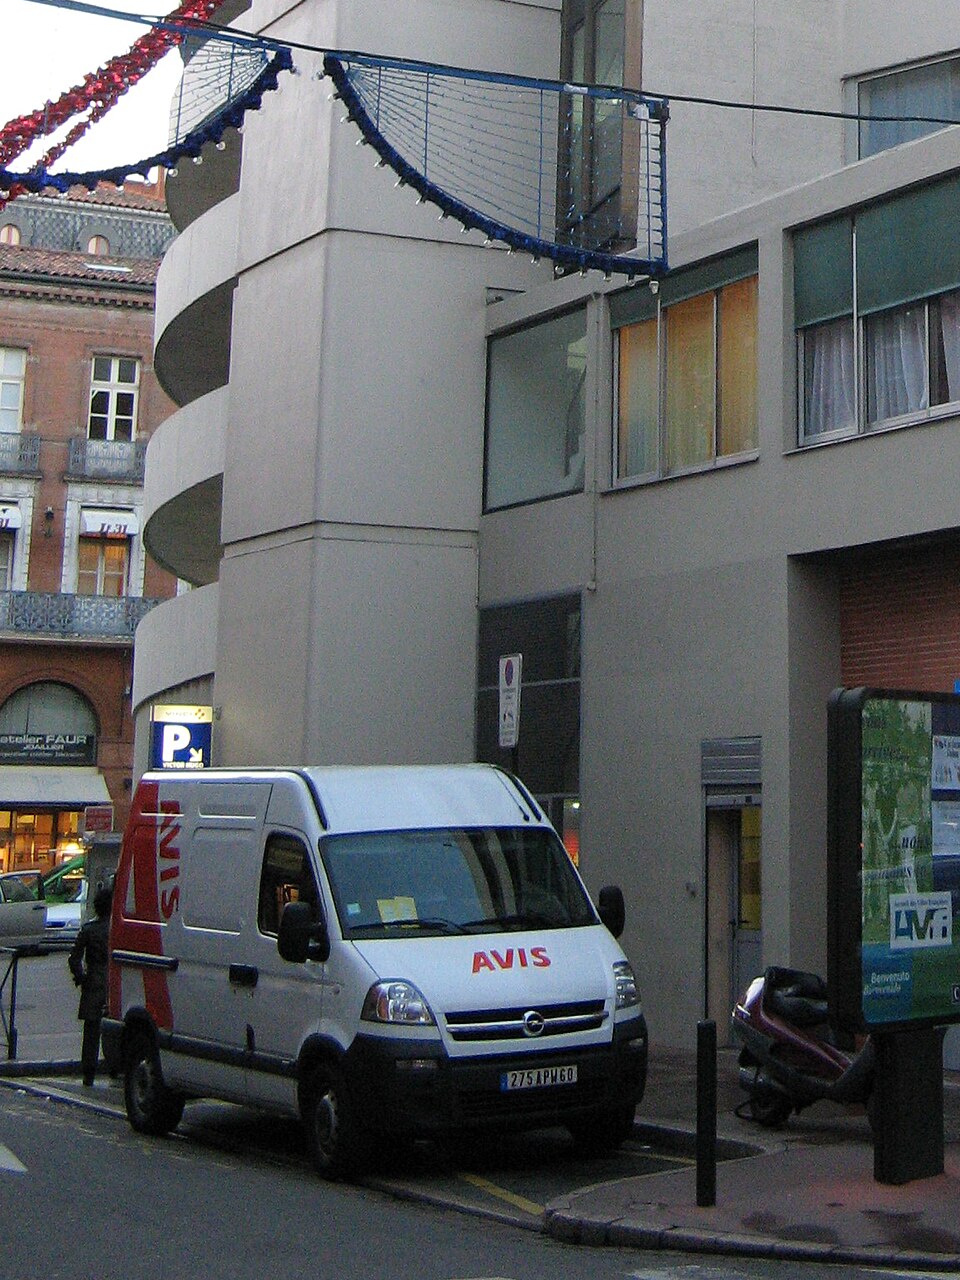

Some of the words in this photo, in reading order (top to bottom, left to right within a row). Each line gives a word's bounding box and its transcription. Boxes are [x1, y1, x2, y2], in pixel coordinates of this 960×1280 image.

[0, 734, 42, 744] atelier
[45, 734, 87, 745] FAUR
[162, 725, 191, 762] P
[159, 800, 181, 920] AVIS
[471, 946, 552, 974] AVIS
